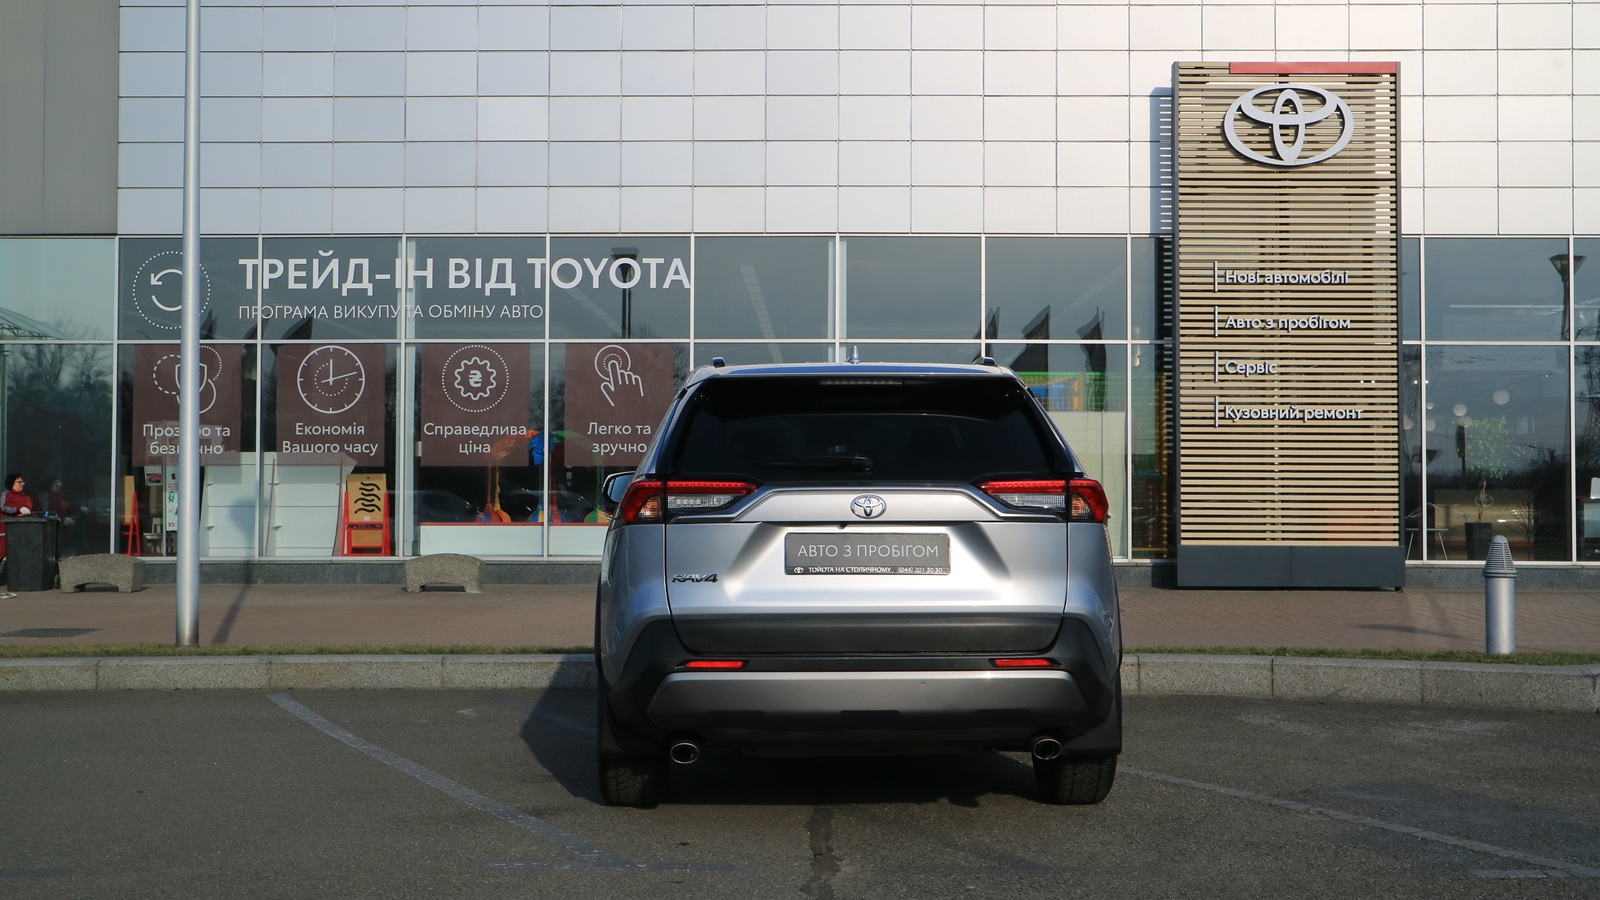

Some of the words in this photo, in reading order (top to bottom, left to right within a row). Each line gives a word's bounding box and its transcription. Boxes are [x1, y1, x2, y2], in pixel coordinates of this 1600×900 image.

[239, 250, 433, 296] ТРЕЙД-ІН
[449, 258, 516, 296] ВІД
[527, 258, 691, 289] TOYOTA
[1225, 270, 1259, 284] Нові
[1264, 270, 1349, 284] автомобілі
[239, 305, 328, 319] ПРОГРАМА
[334, 305, 400, 318] ВИКУПУ
[429, 304, 496, 318] ОБМІНУ
[500, 304, 543, 318] АВТО
[1225, 315, 1262, 329] Авто
[1264, 318, 1274, 329] з
[1279, 315, 1351, 332] пробігом
[1225, 360, 1278, 377] Сервіс
[1225, 405, 1299, 422] Кузовний
[1304, 408, 1363, 422] ремонт
[143, 424, 211, 439] Прозо
[215, 427, 230, 436] та
[295, 423, 365, 435] Економія
[423, 423, 527, 437] Справедлива
[587, 423, 632, 435] Легко
[636, 425, 651, 435] та
[282, 441, 340, 453] Вашого
[344, 443, 378, 456] часу
[459, 441, 491, 454] ціна
[592, 443, 647, 456] зручно
[797, 545, 838, 558] АВТО
[857, 545, 939, 558] ПРОБІГОМ
[808, 565, 834, 573] ТОЙОТА
[672, 573, 719, 583] RAV4
